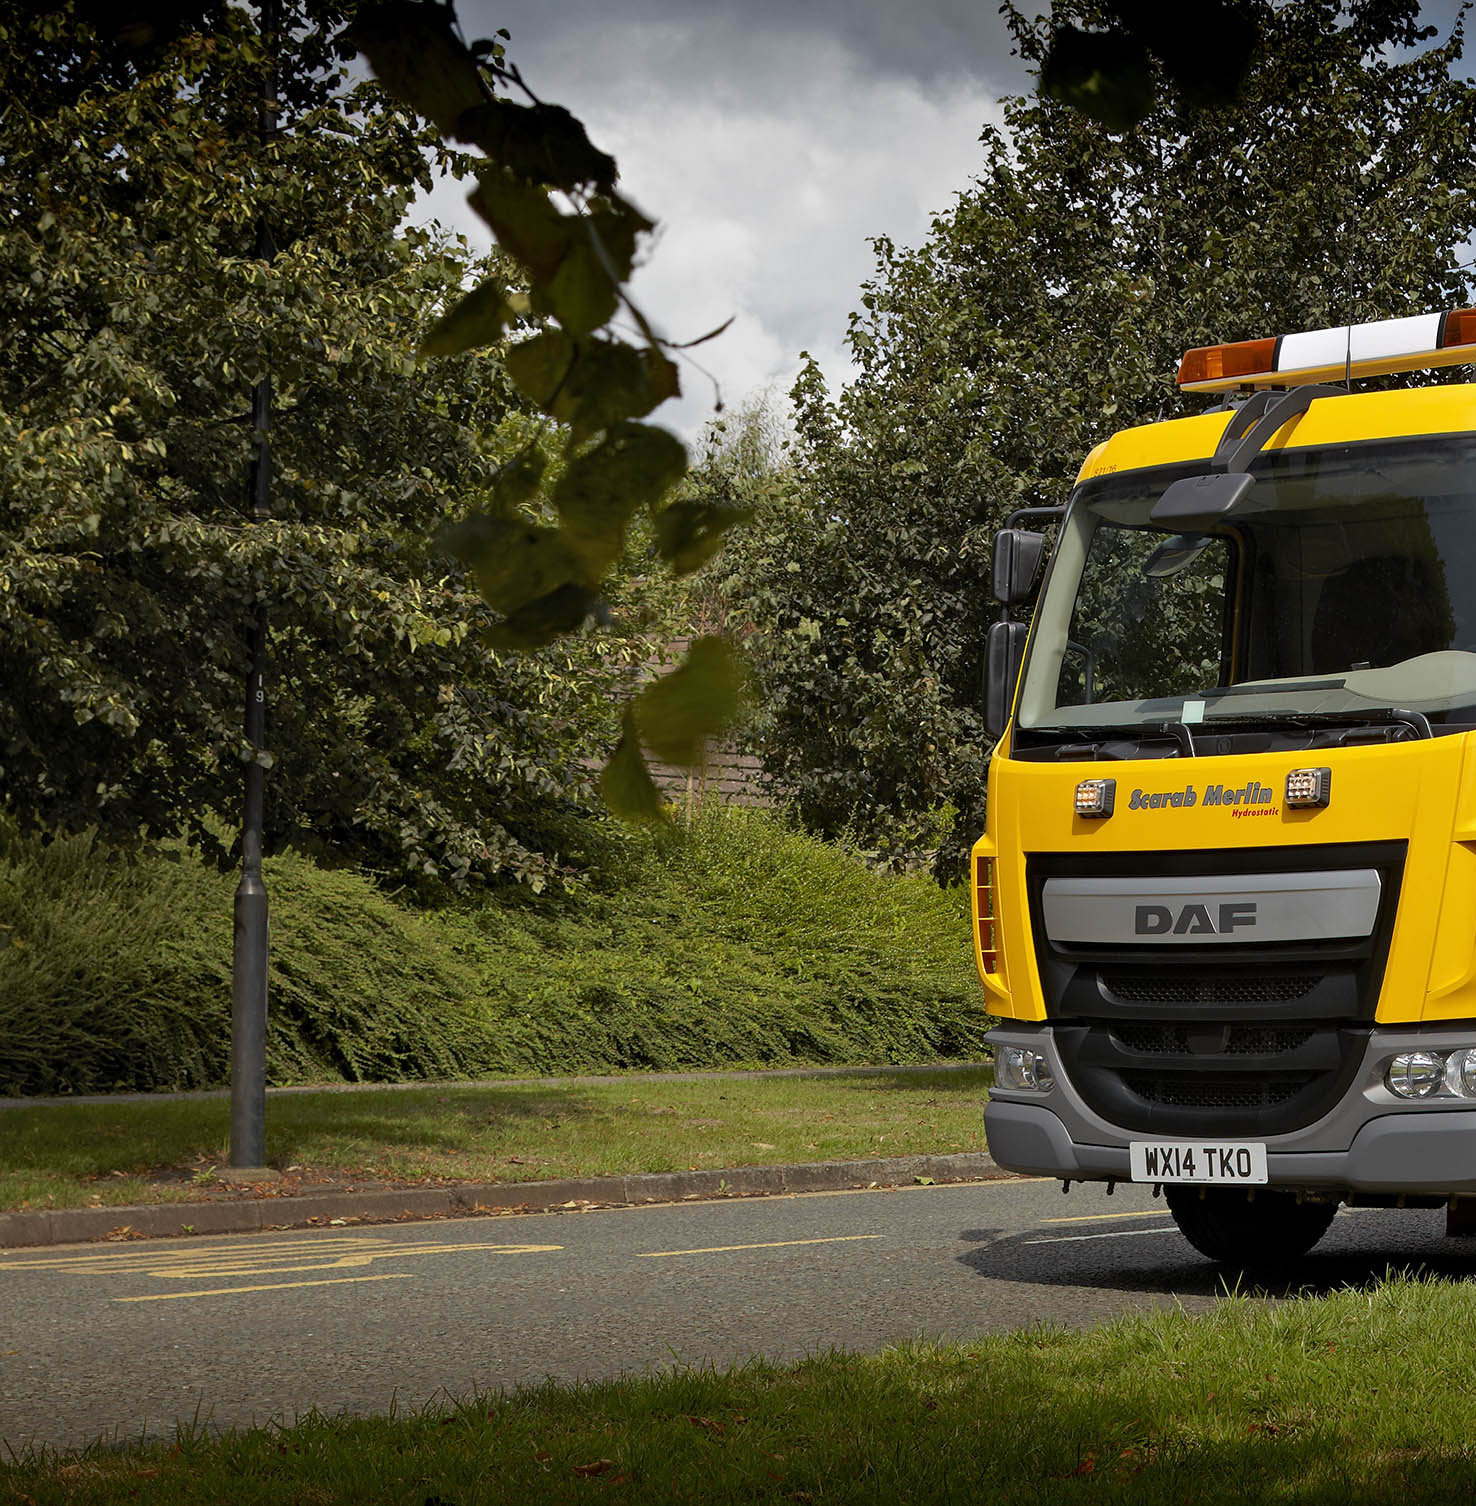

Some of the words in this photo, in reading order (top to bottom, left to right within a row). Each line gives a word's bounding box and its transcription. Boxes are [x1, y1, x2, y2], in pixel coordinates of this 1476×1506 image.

[1128, 785, 1198, 811] Scarab
[1202, 782, 1273, 807] Merlin
[1231, 807, 1280, 819] Hydrostatic
[1134, 903, 1257, 936] DAF
[1145, 1147, 1196, 1177] WX14
[1203, 1148, 1252, 1178] TKO
